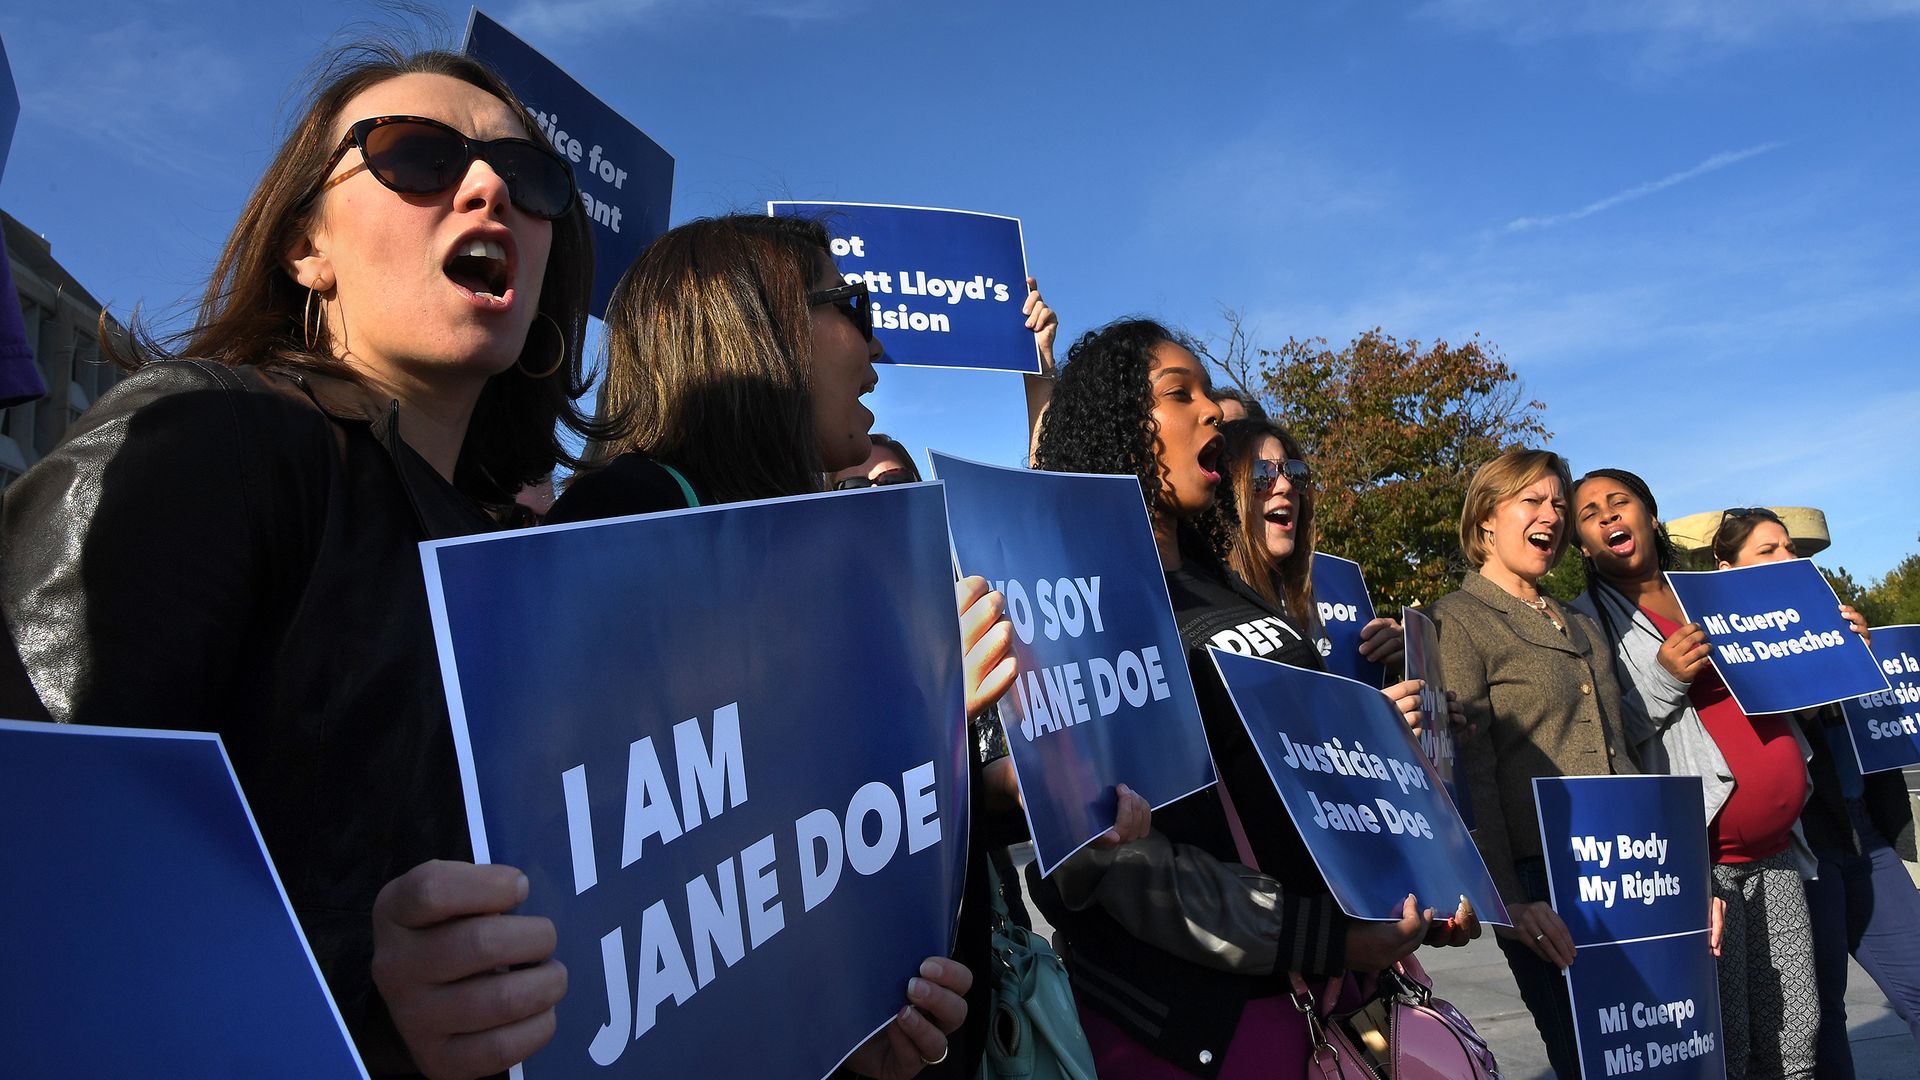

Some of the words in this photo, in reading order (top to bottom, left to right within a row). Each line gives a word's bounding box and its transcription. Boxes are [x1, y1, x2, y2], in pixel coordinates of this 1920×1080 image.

[589, 145, 628, 190] for
[580, 191, 623, 234] ant
[841, 271, 893, 294] ott
[899, 271, 1010, 305] Lloyd's
[871, 302, 950, 332] ision
[1036, 575, 1105, 641] SOY
[1317, 602, 1357, 627] por
[1703, 616, 1731, 636] Mi
[1730, 608, 1801, 632] Cuerpo
[1718, 645, 1756, 665] Mis
[1754, 629, 1845, 661] Derechos
[1882, 658, 1903, 675] es
[1900, 652, 1920, 673] la
[1019, 661, 1092, 742] JANE
[1087, 646, 1171, 718] DOE
[1859, 682, 1920, 709] decisió
[1867, 716, 1918, 740] Scott
[1278, 731, 1391, 781] Justicia
[1387, 758, 1430, 795] por
[561, 763, 598, 896] I
[621, 701, 748, 869] AM
[1307, 790, 1381, 834] Jane
[1375, 798, 1434, 840] Doe
[1571, 836, 1612, 868] My
[1617, 832, 1668, 865] Body
[1578, 876, 1617, 909] My
[1621, 871, 1681, 905] Rights
[588, 833, 785, 1066] JANE
[795, 760, 942, 913] DOE
[1598, 1002, 1628, 1035] Mi
[1631, 998, 1695, 1034] Cuerpo
[1603, 1043, 1644, 1077] Mis
[1646, 1031, 1715, 1070] Derechos
